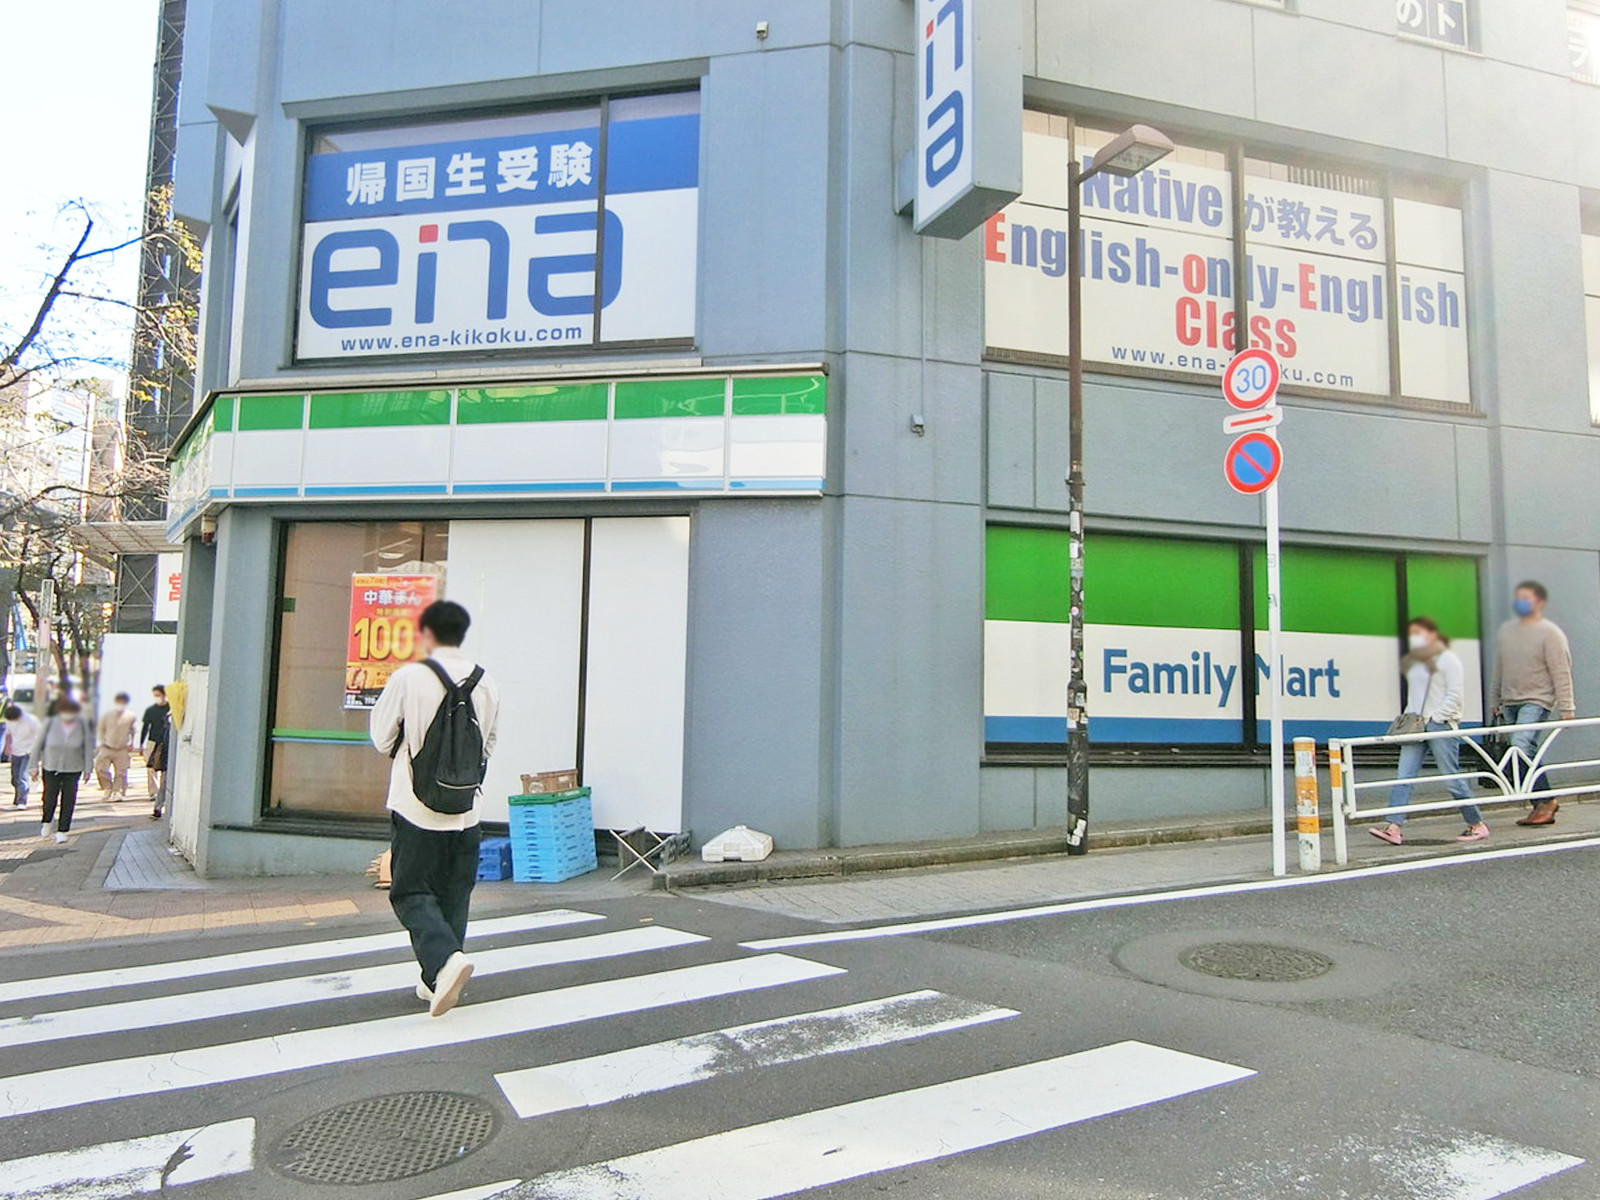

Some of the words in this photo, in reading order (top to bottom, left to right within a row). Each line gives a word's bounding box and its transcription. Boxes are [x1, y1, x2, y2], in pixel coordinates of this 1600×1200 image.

[346, 141, 593, 206] 帰国生受験
[1083, 155, 1223, 227] Native
[1245, 193, 1378, 251] が教える
[341, 325, 582, 351] www.ena-kikoku.com
[1176, 296, 1297, 358] Class
[1236, 365, 1267, 393] 30
[354, 617, 414, 660] 100
[1103, 648, 1237, 708] Family
